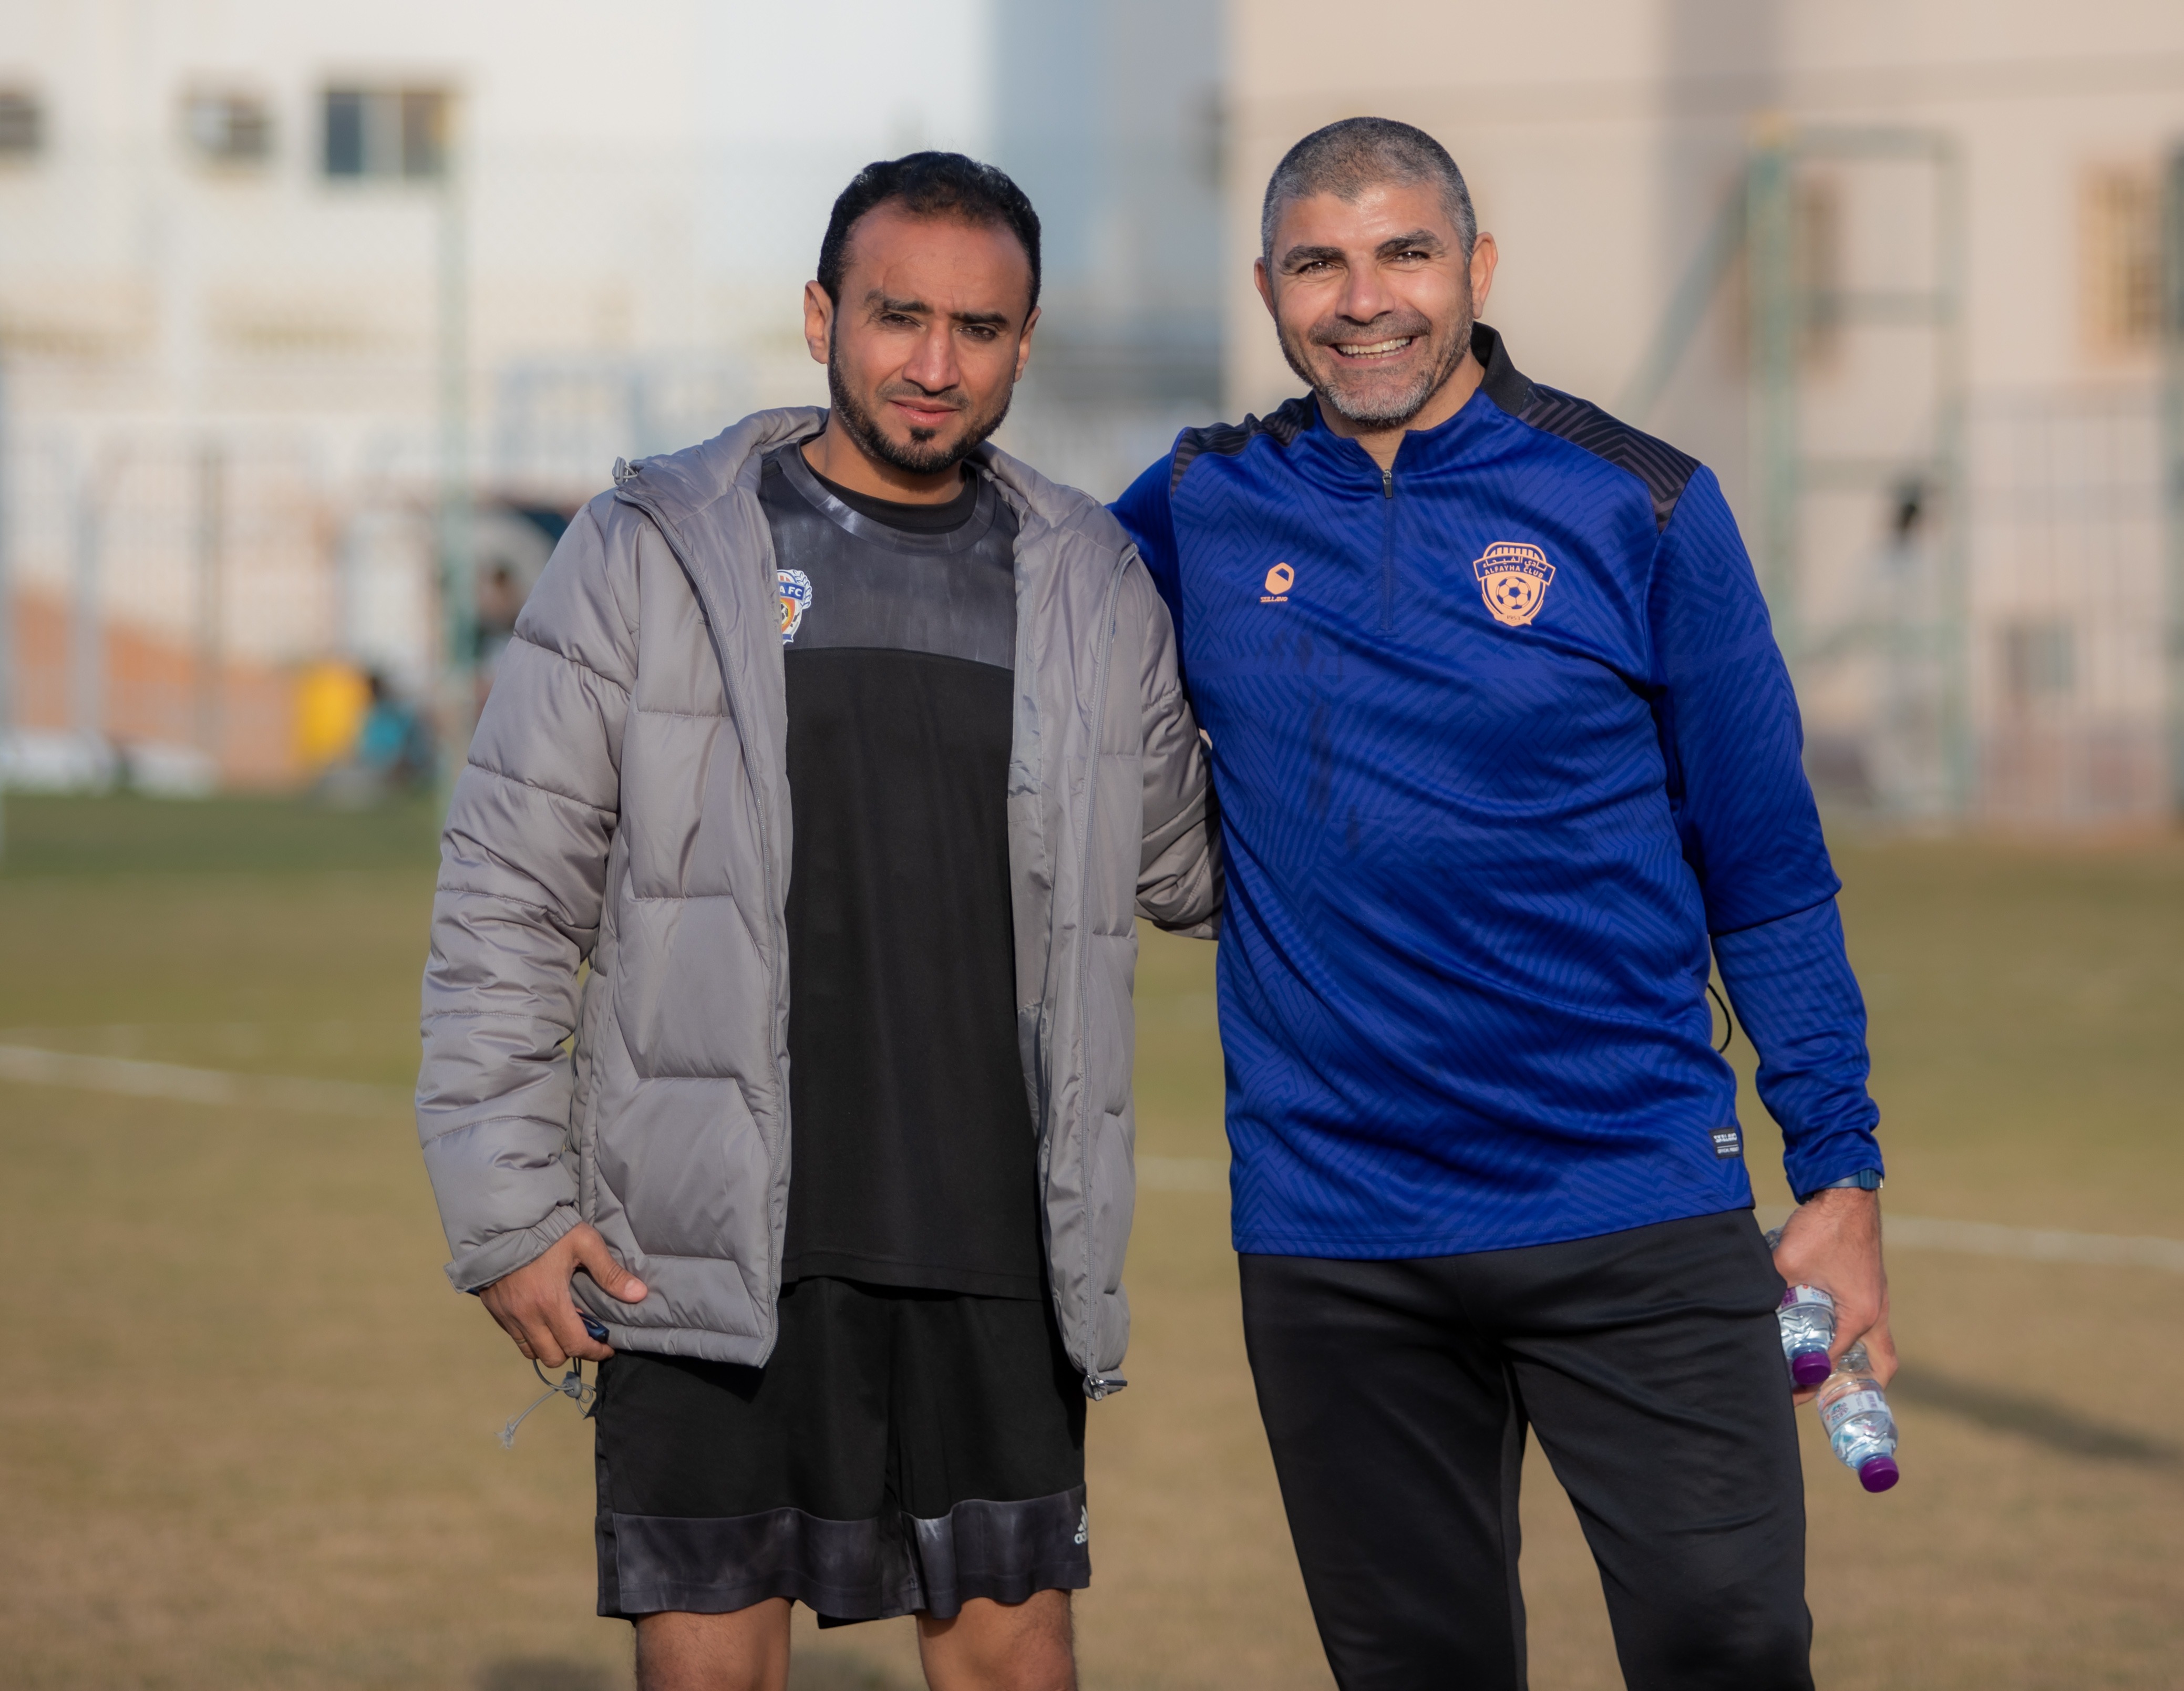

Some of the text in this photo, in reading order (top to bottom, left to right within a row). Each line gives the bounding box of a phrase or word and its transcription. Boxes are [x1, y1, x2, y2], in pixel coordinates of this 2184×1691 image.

[1485, 565, 1544, 578] ALFAYHA CLUB
[788, 586, 802, 597] FC
